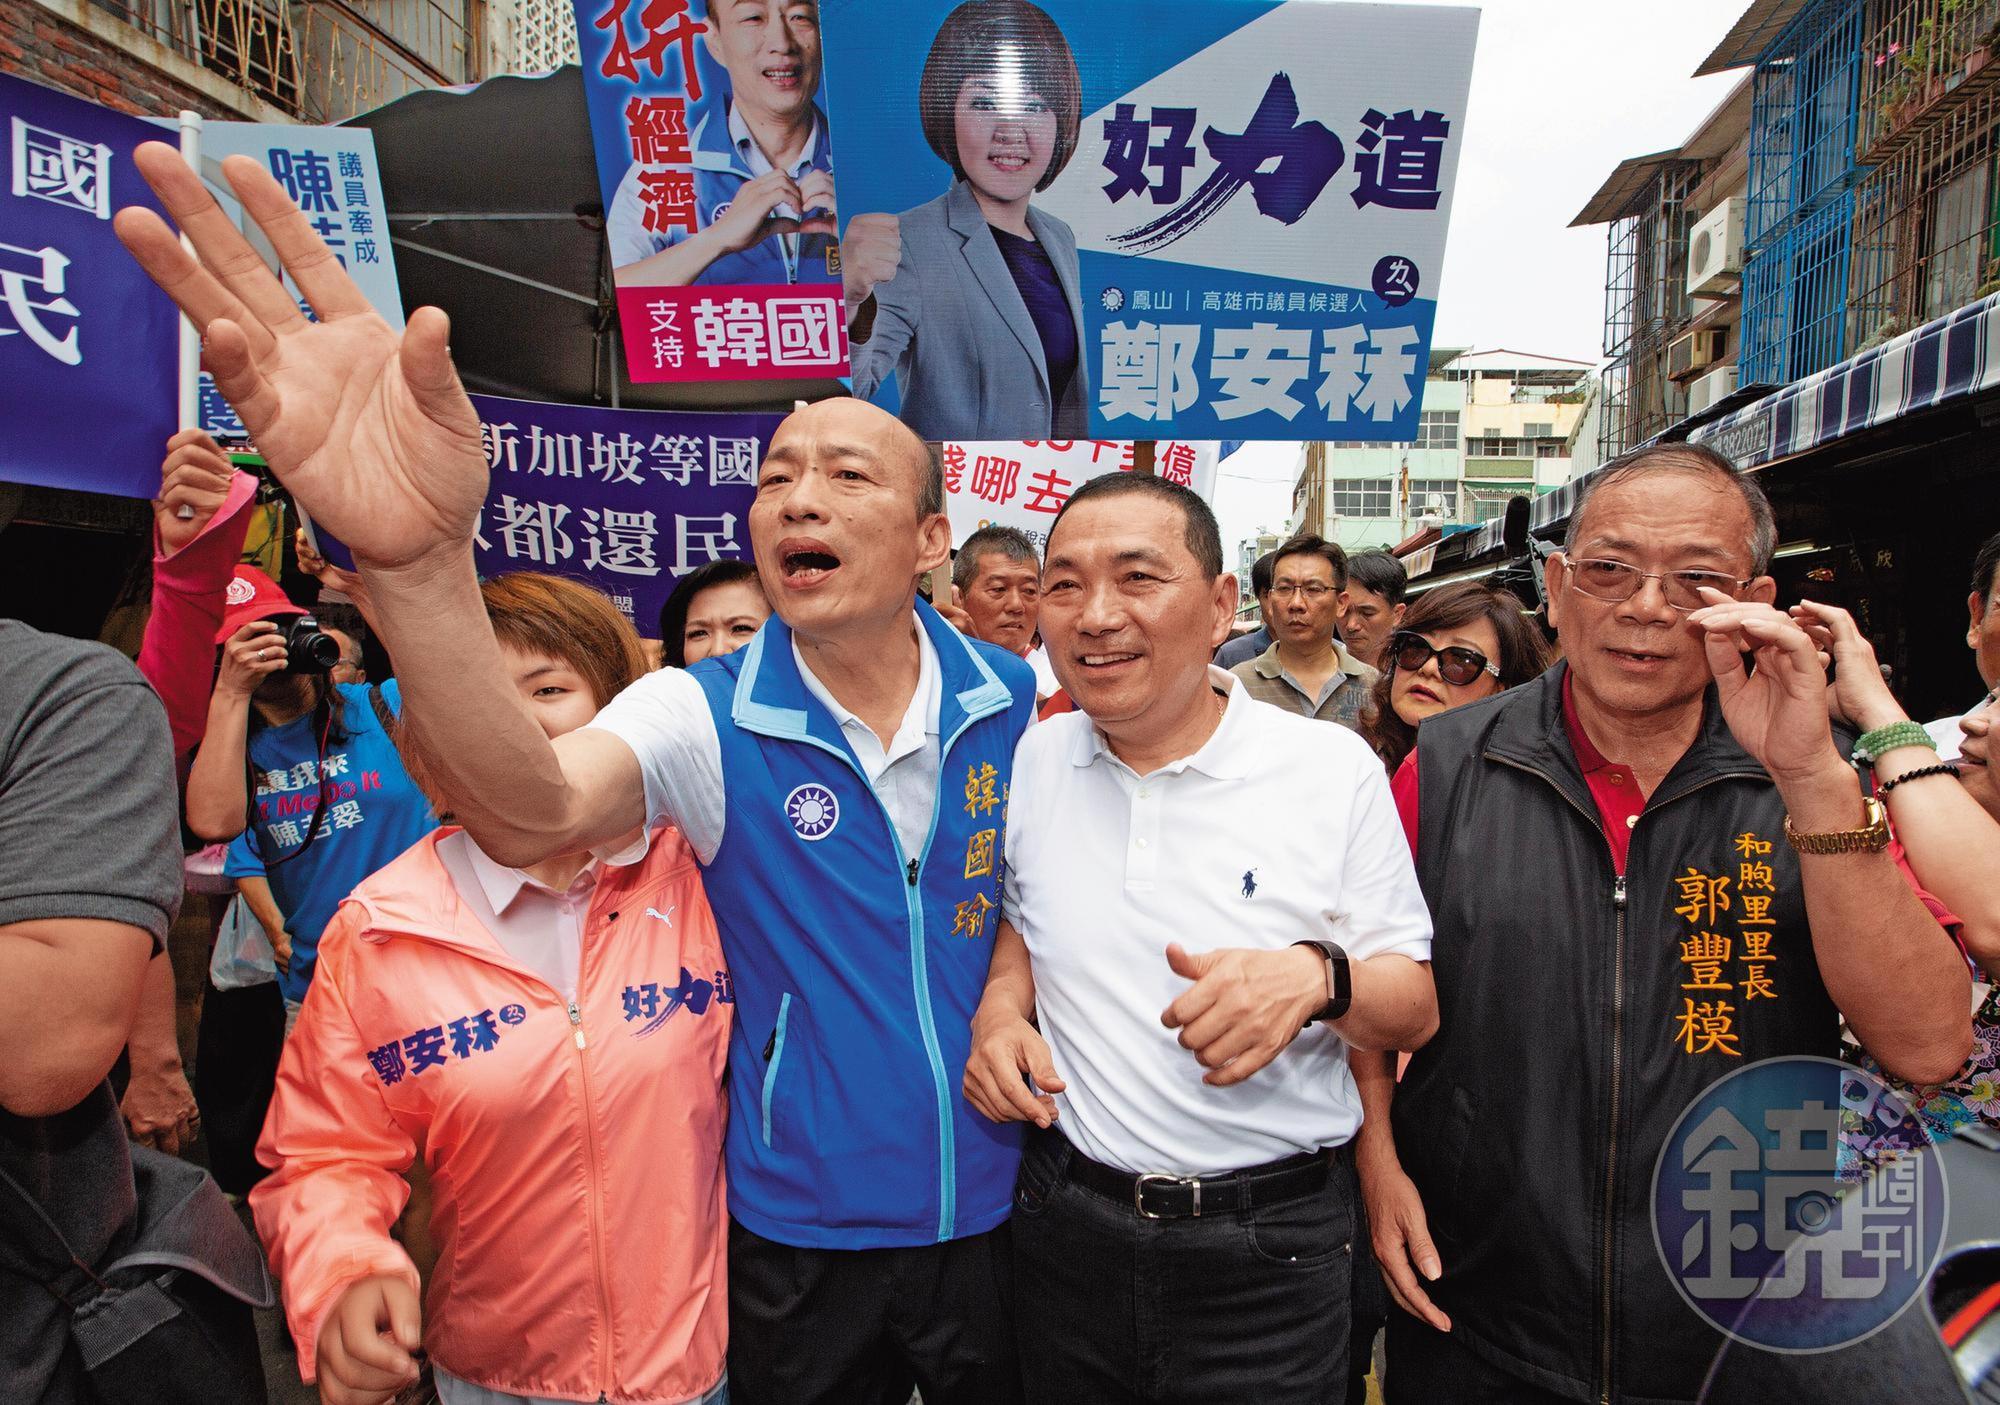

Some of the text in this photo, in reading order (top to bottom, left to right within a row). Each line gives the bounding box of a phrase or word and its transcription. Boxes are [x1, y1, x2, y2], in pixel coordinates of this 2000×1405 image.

[11, 116, 114, 220] 國
[595, 0, 708, 235] 拼經濟
[1101, 71, 1451, 258] 好力道
[337, 152, 379, 264] 議員牽成
[0, 246, 83, 366] 民
[646, 299, 685, 369] 支持
[691, 297, 850, 369] 韓國
[1131, 290, 1369, 313] 鳳山 高雄市議員候選人
[1098, 320, 1421, 422] 鄭安秝
[479, 422, 761, 487] 新加坡等國
[474, 494, 743, 579] 都還民
[361, 769, 382, 792] It
[951, 761, 1000, 939] 韓國瑜
[1675, 867, 1742, 1057] 郭豐模
[367, 1009, 500, 1086] 鄭安秝
